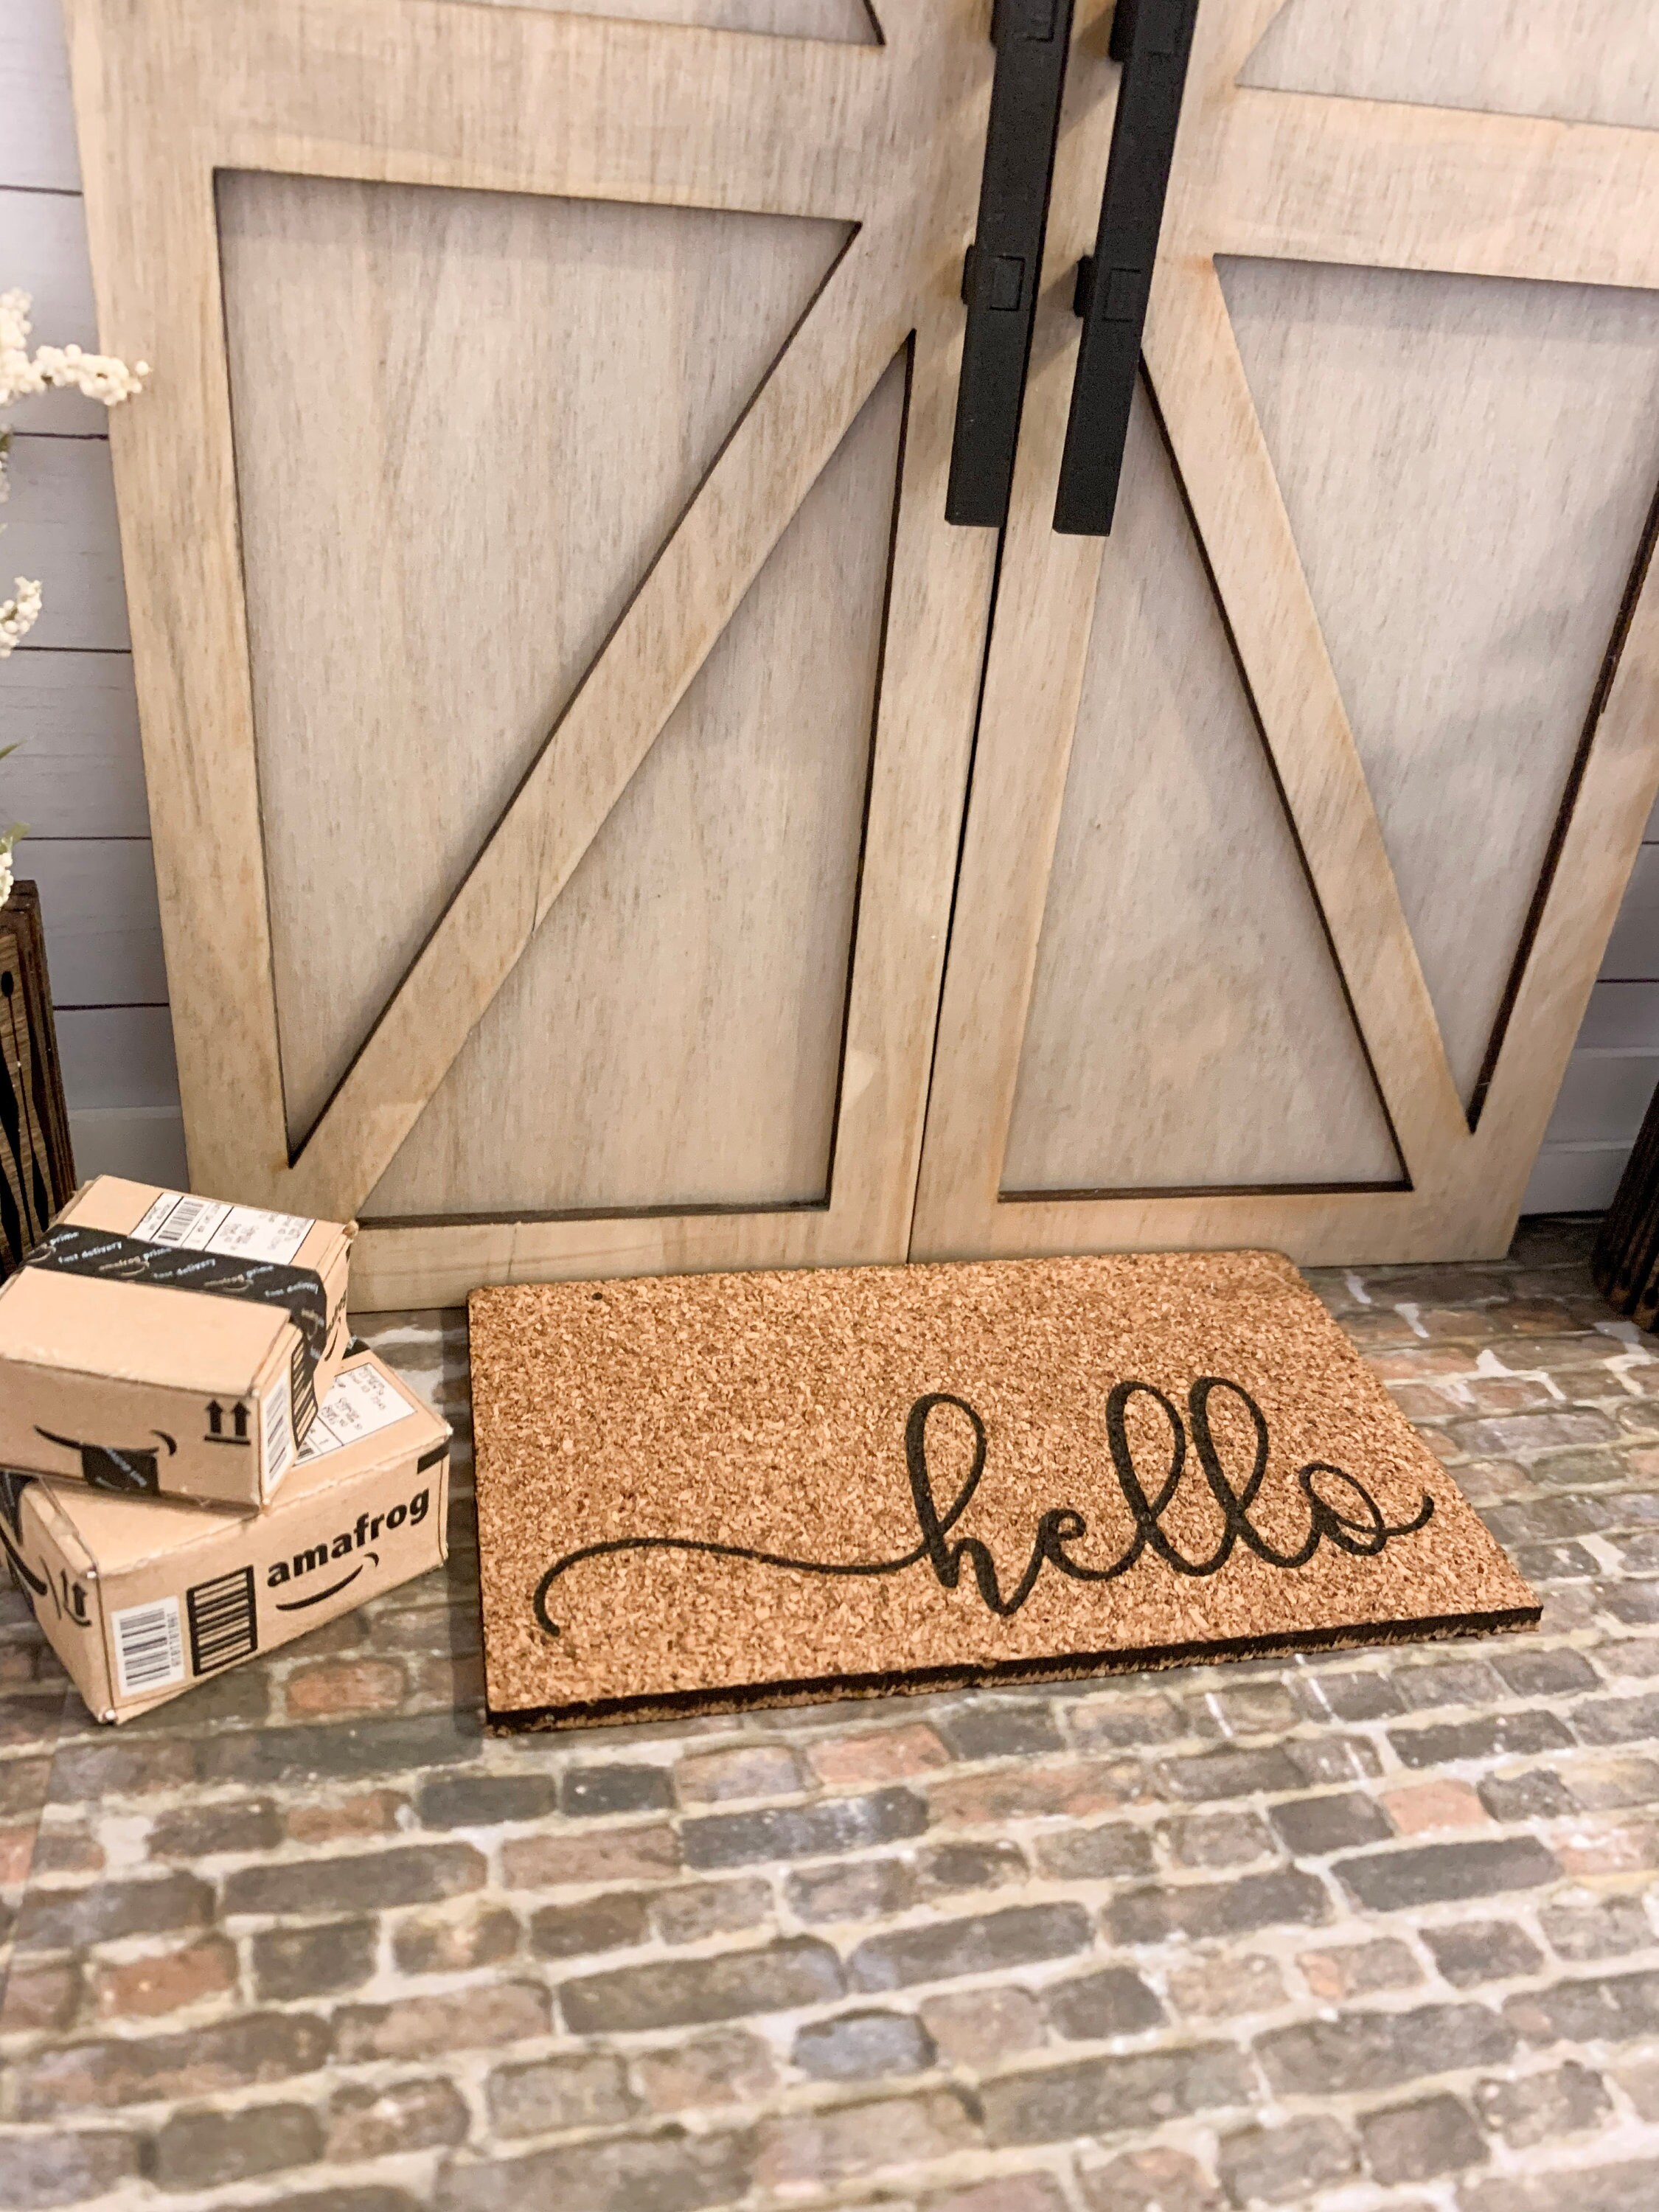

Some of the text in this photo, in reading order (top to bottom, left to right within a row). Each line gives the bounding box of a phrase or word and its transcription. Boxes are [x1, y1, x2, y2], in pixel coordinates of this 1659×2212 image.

[81, 1240, 122, 1259] delivery
[175, 1257, 217, 1276] delivery
[534, 1376, 1435, 1637] hello
[267, 1487, 430, 1588] amafrog
